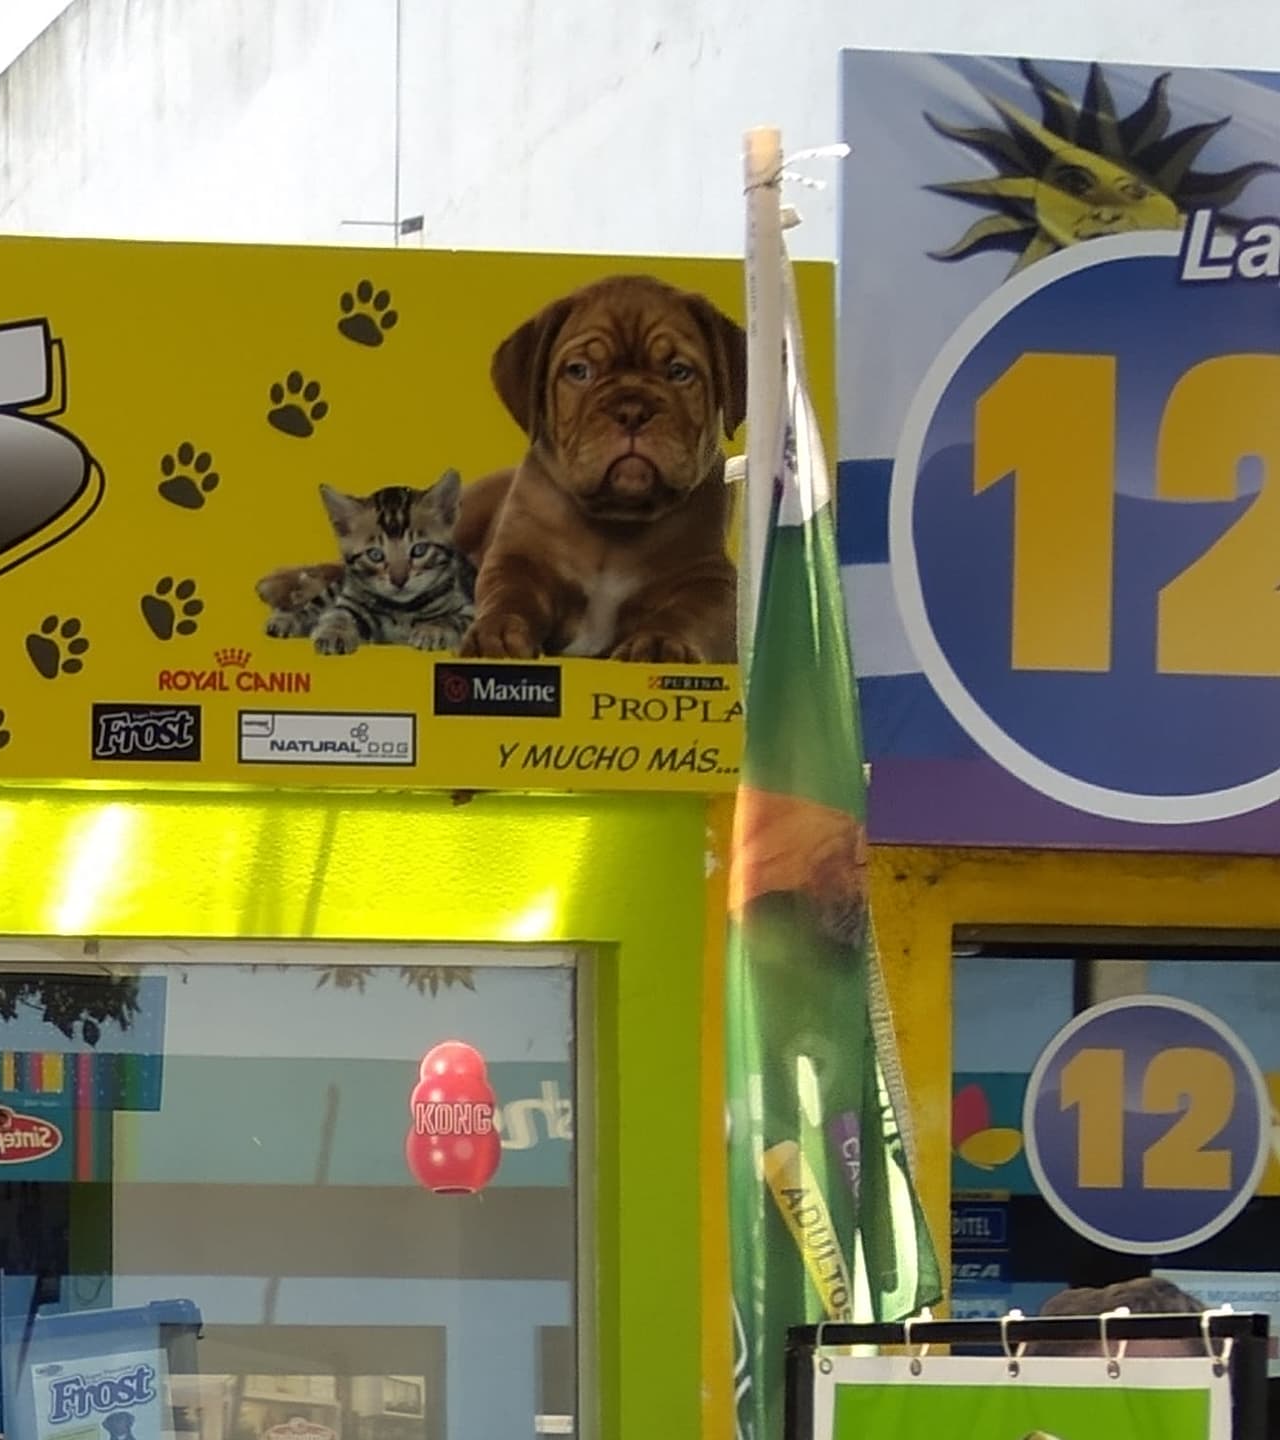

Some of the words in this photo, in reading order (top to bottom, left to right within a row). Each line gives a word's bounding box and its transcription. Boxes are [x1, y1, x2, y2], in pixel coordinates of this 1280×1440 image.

[973, 351, 1280, 675] 12
[159, 669, 229, 692] ROYAL
[236, 671, 311, 693] CANIN
[473, 677, 555, 701] Maxine
[675, 695, 744, 723] PLA
[96, 710, 195, 757] Frost
[270, 739, 361, 754] NATURAL
[368, 741, 409, 755] DOG
[497, 742, 519, 769] Y
[522, 744, 639, 772] MUCHO
[647, 739, 740, 774] MÁS...
[415, 1102, 493, 1136] KONG
[1060, 1048, 1235, 1190] 12
[49, 1364, 155, 1424] Frost
